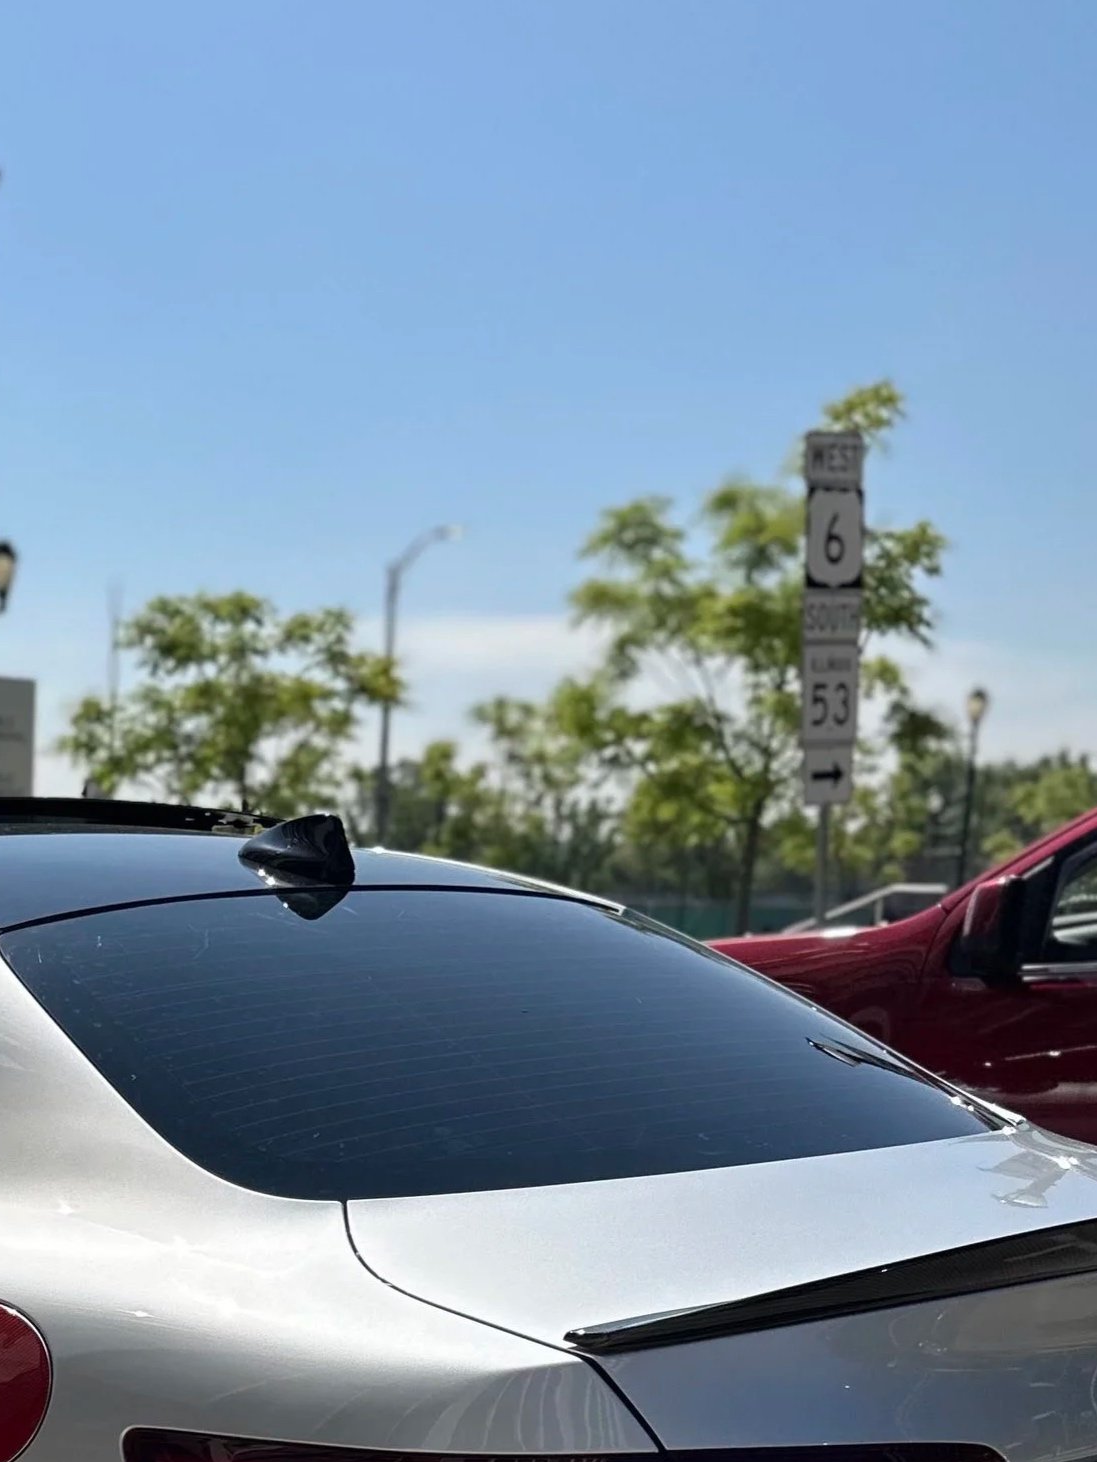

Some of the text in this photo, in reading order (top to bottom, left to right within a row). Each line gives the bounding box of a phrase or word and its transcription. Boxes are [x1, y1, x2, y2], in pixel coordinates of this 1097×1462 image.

[811, 444, 860, 473] WEST
[824, 511, 846, 566] 6
[806, 604, 857, 632] SOUTH
[810, 682, 852, 727] 53
